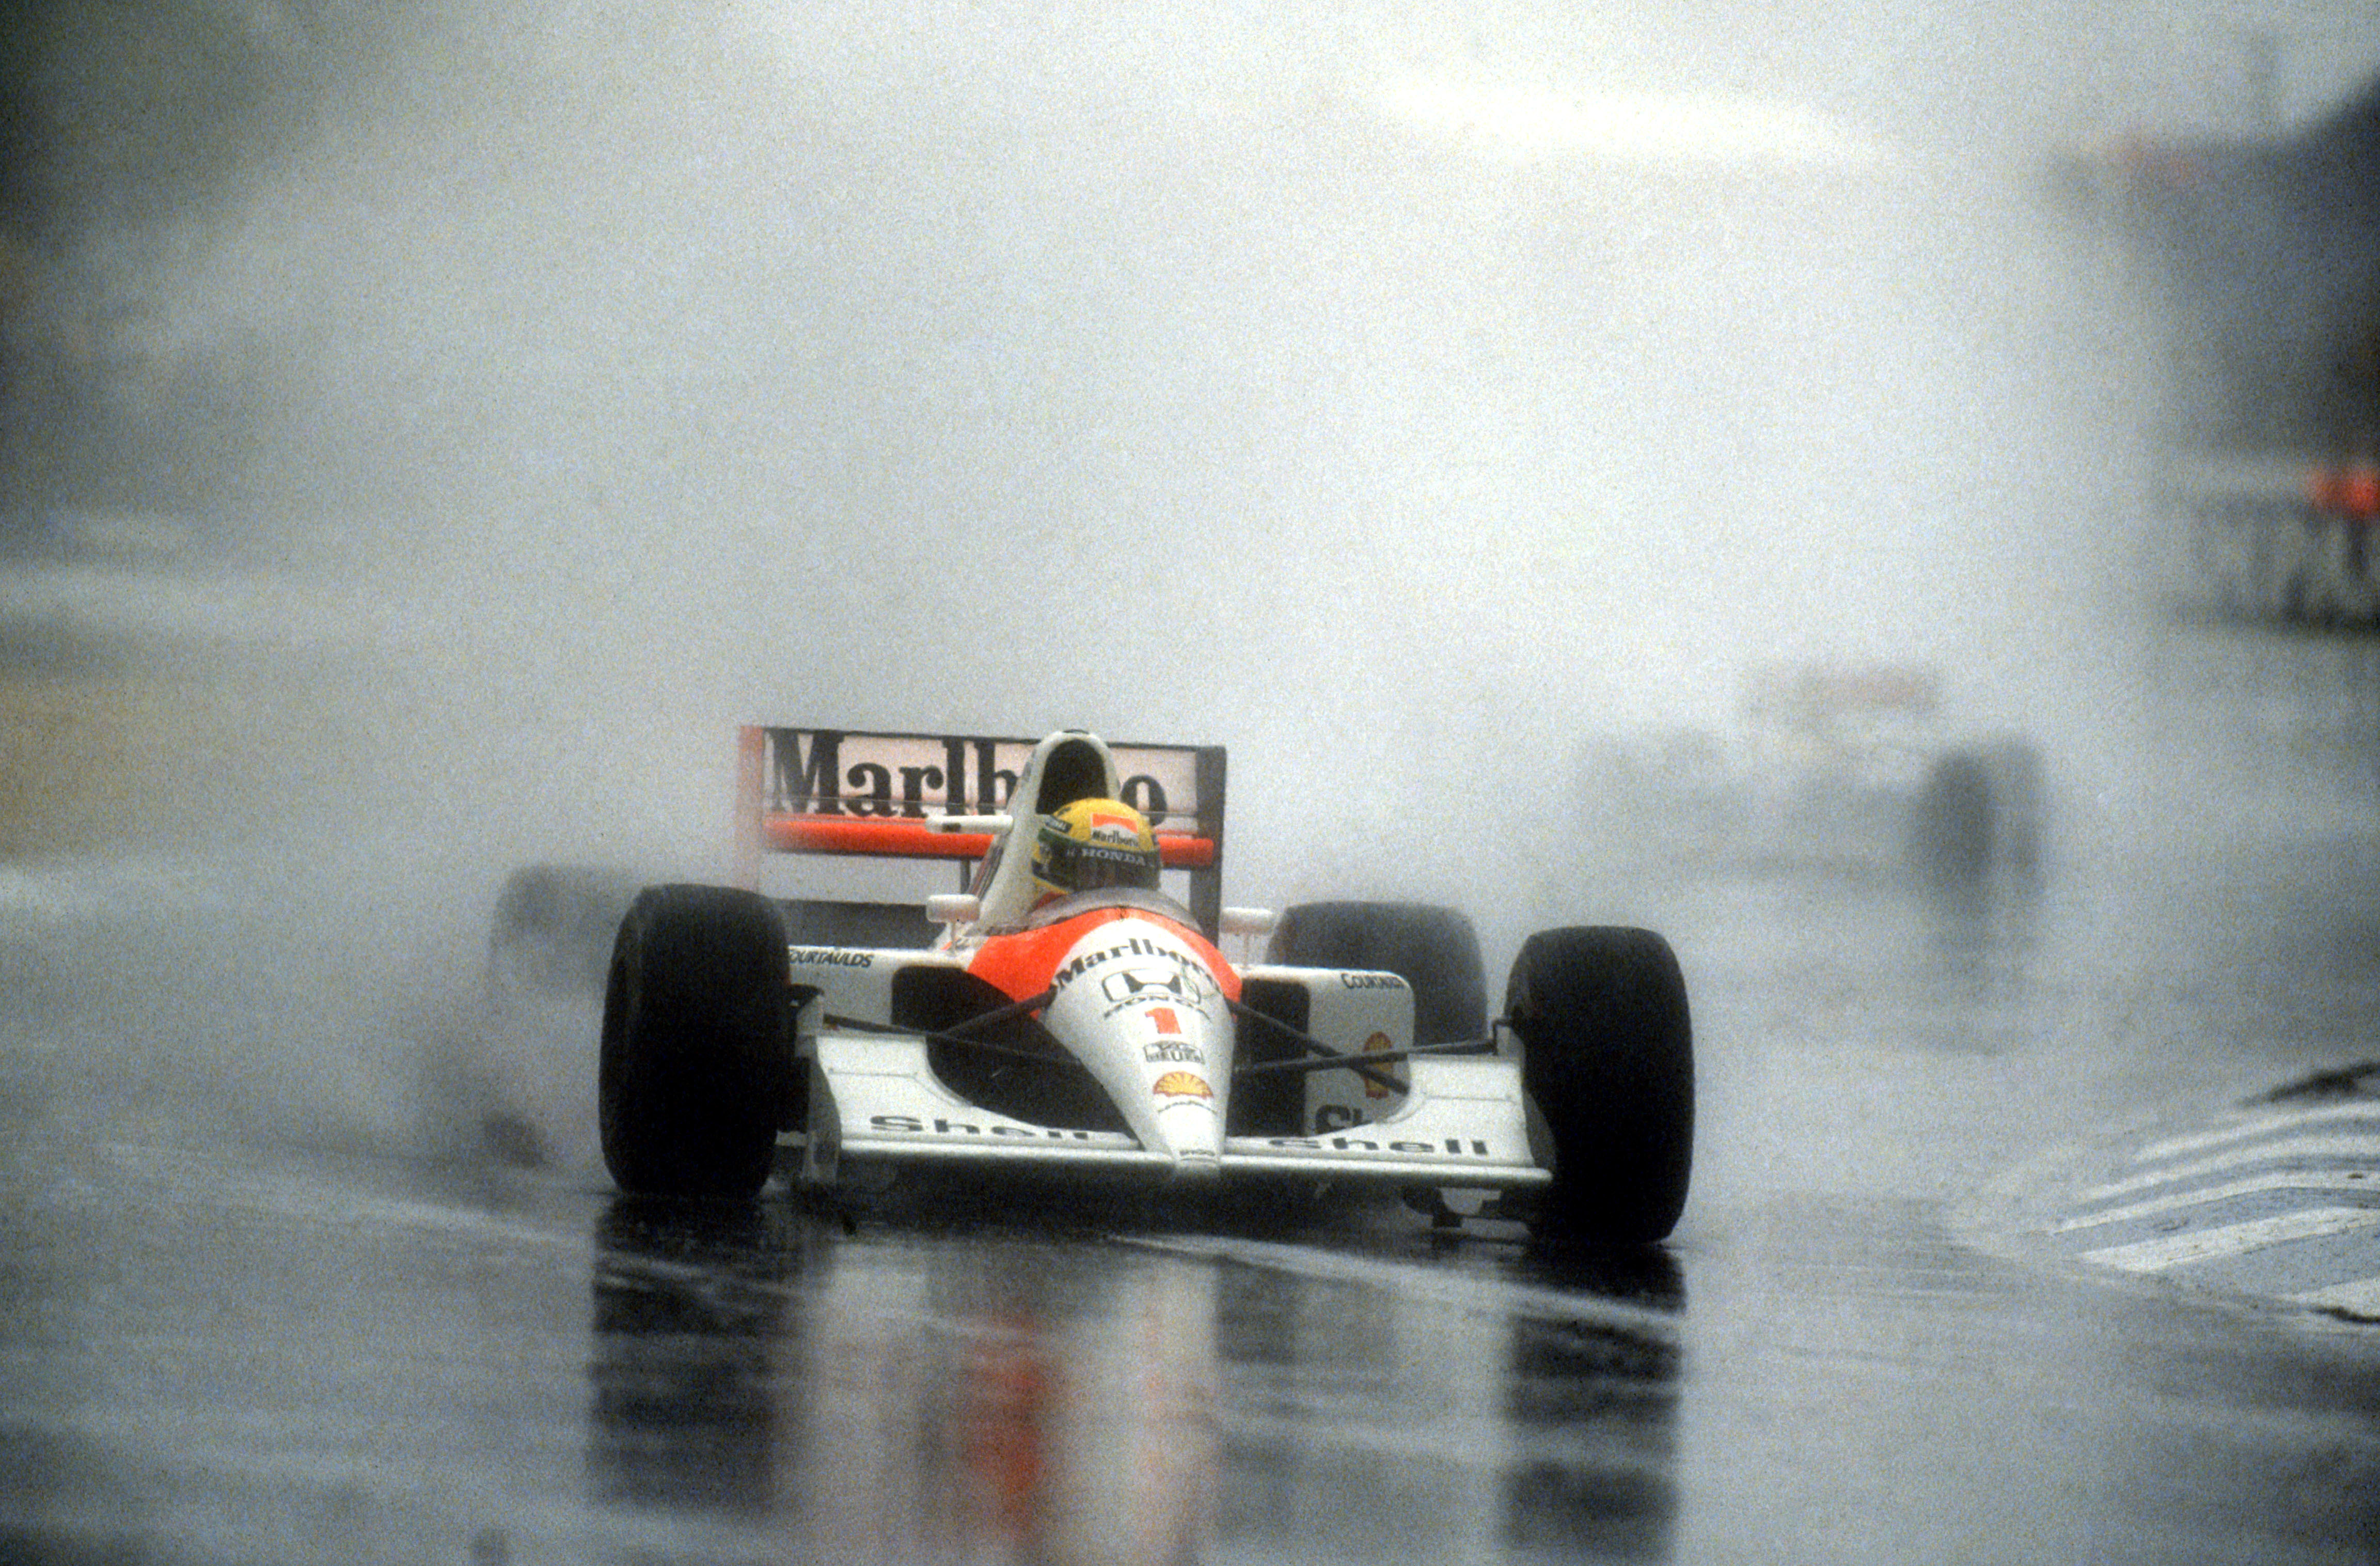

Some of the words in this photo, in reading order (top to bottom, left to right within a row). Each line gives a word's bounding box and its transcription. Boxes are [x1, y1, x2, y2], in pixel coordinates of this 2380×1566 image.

[766, 728, 1167, 826] Marlbo
[1082, 848, 1146, 866] HONDA
[1144, 1007, 1183, 1035] 1
